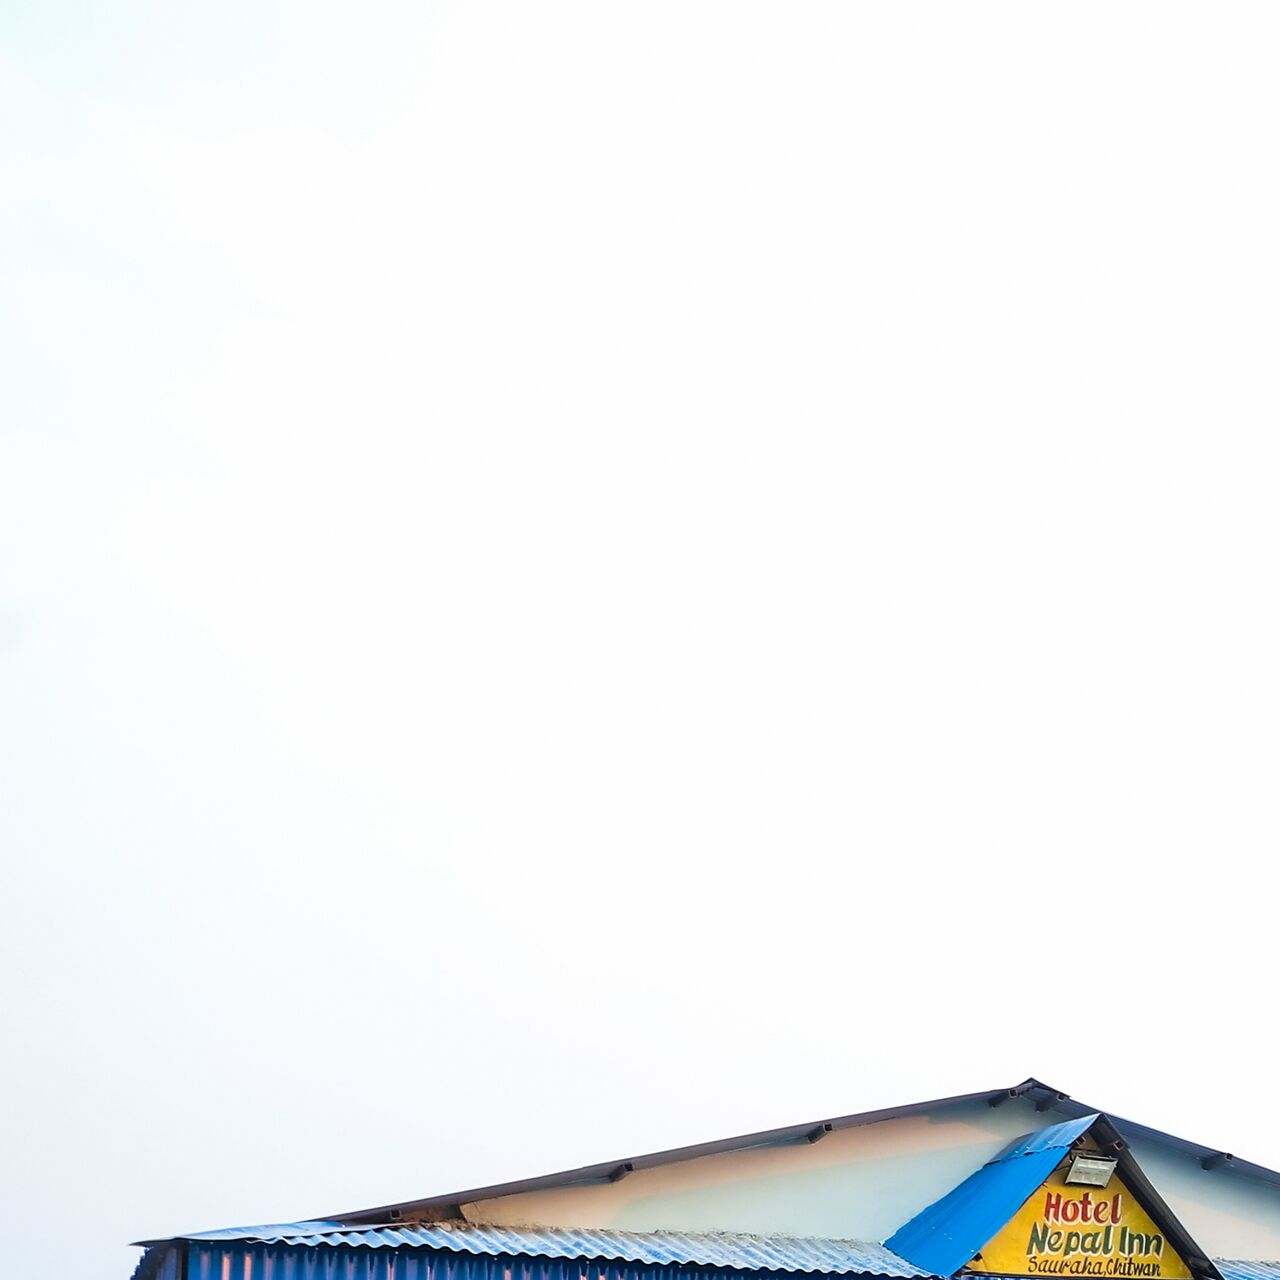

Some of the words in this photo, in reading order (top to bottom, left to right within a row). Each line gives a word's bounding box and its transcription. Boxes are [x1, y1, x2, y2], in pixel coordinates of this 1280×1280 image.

[1043, 1191, 1122, 1226] Hotel
[1026, 1221, 1114, 1259] Nepal
[1118, 1225, 1164, 1259] Inn
[1106, 1258, 1162, 1277] Chitwan
